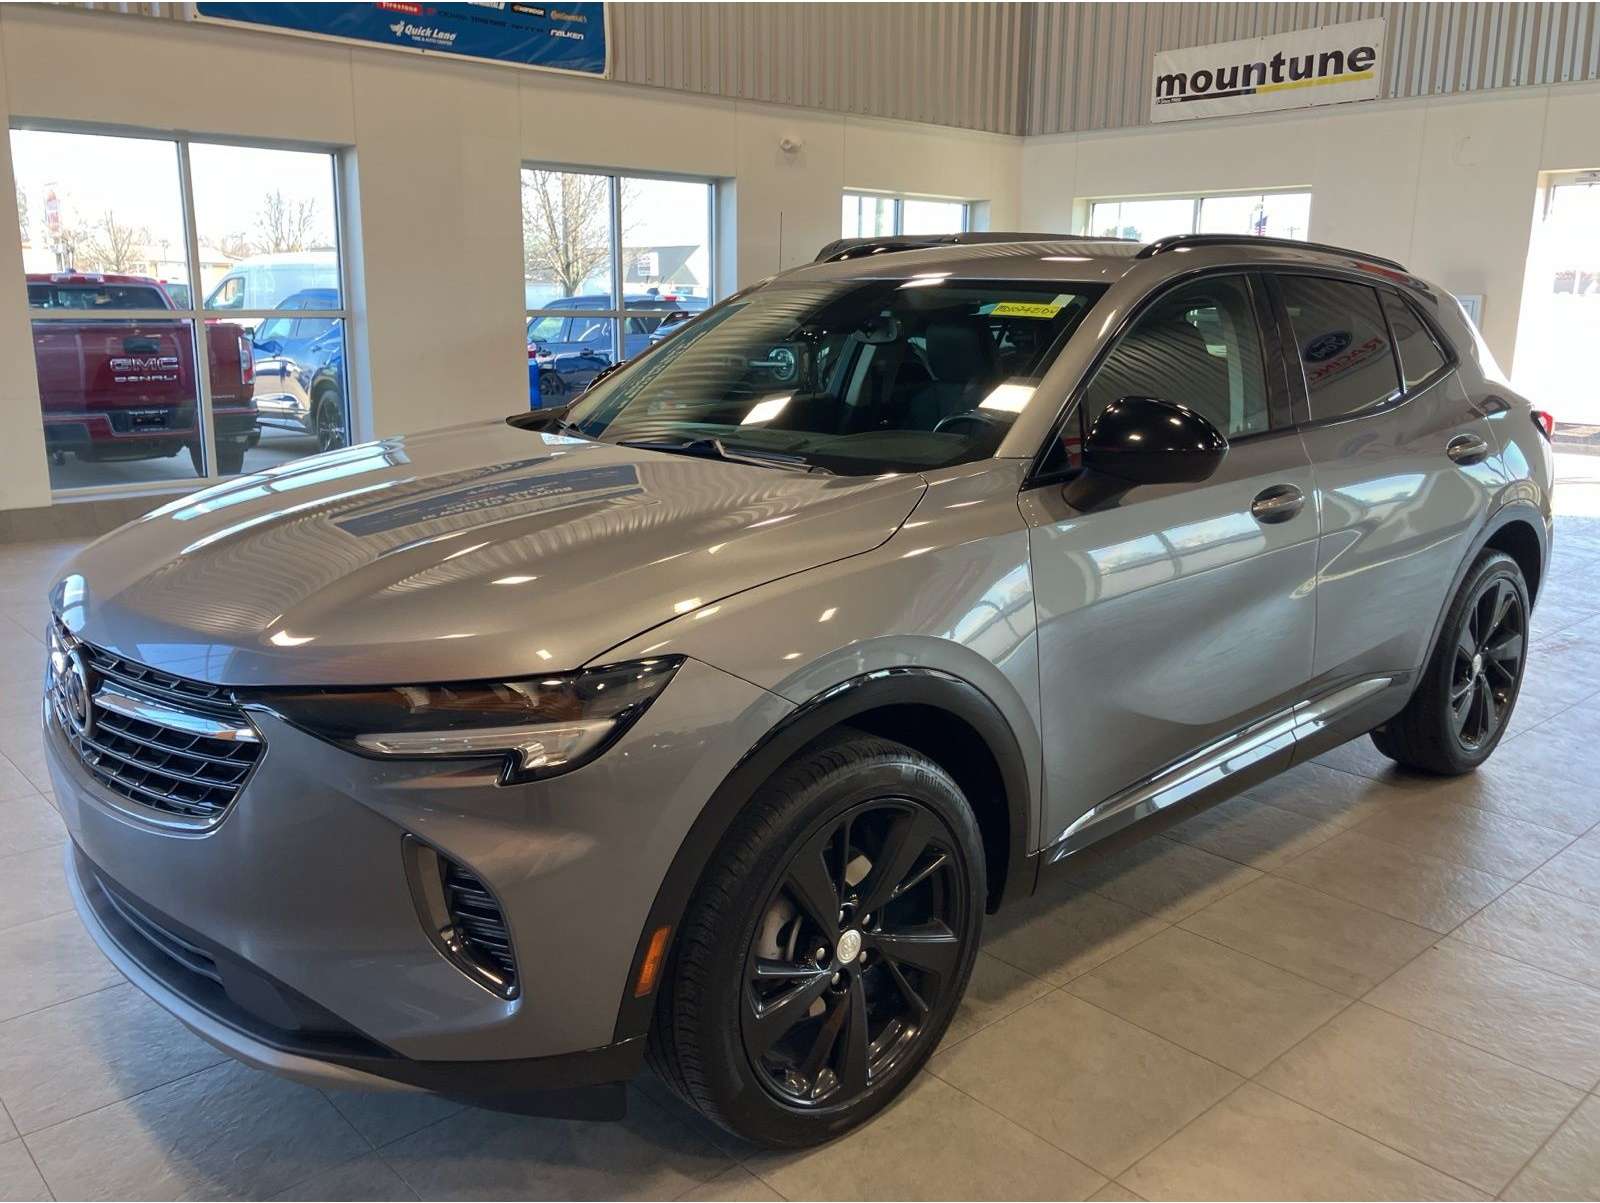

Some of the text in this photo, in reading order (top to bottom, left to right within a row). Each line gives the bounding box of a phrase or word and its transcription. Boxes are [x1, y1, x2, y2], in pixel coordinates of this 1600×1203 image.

[404, 24, 433, 37] Quick
[550, 29, 584, 40] FALKEN
[1156, 46, 1376, 97] mountune
[110, 357, 178, 371] GMC
